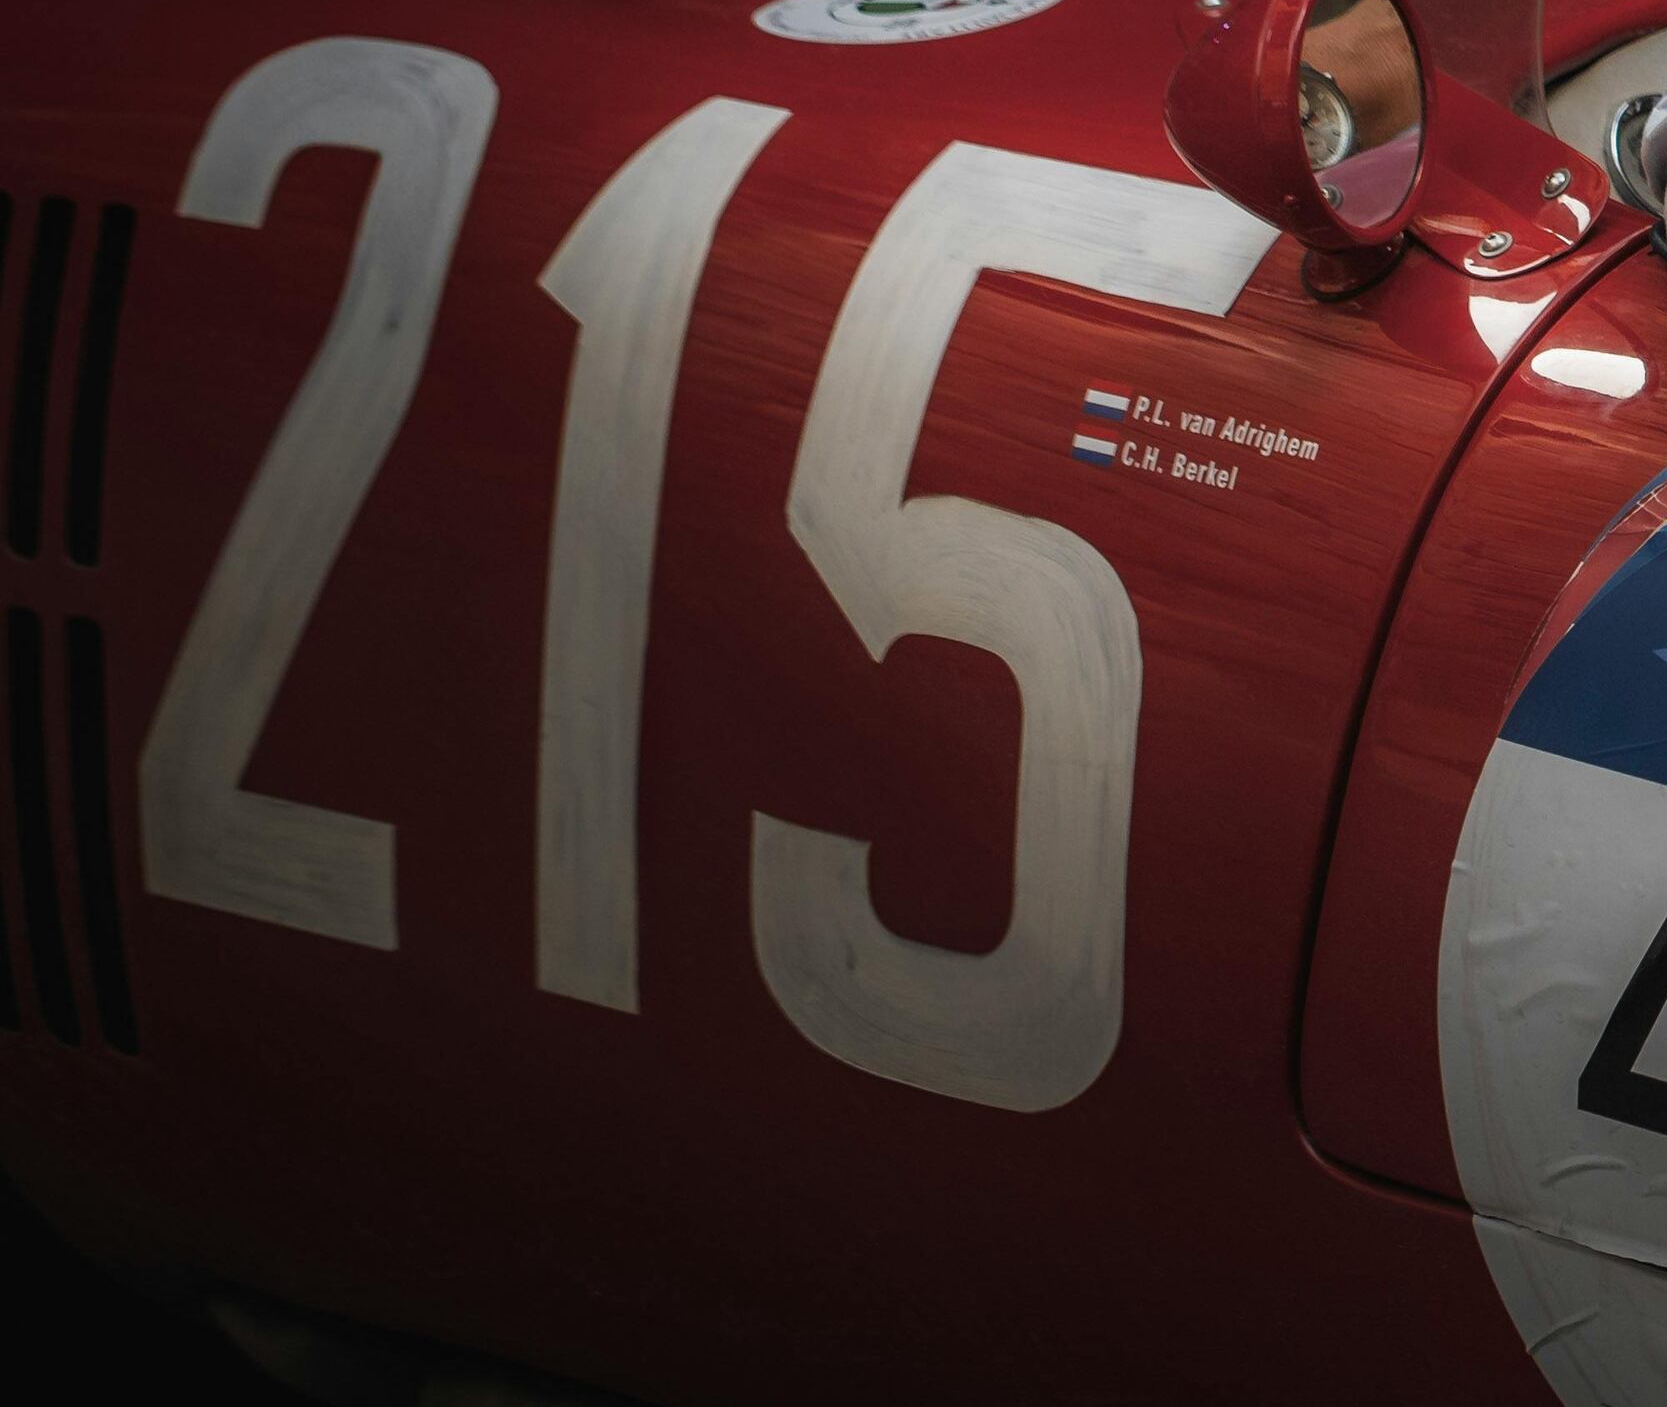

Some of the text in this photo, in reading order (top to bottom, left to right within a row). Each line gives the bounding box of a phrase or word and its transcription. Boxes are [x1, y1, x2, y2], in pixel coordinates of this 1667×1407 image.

[1132, 395, 1320, 461] P.L. van Adrighem
[1120, 441, 1239, 491] C.H. Berkel
[138, 35, 1283, 1113] 215
